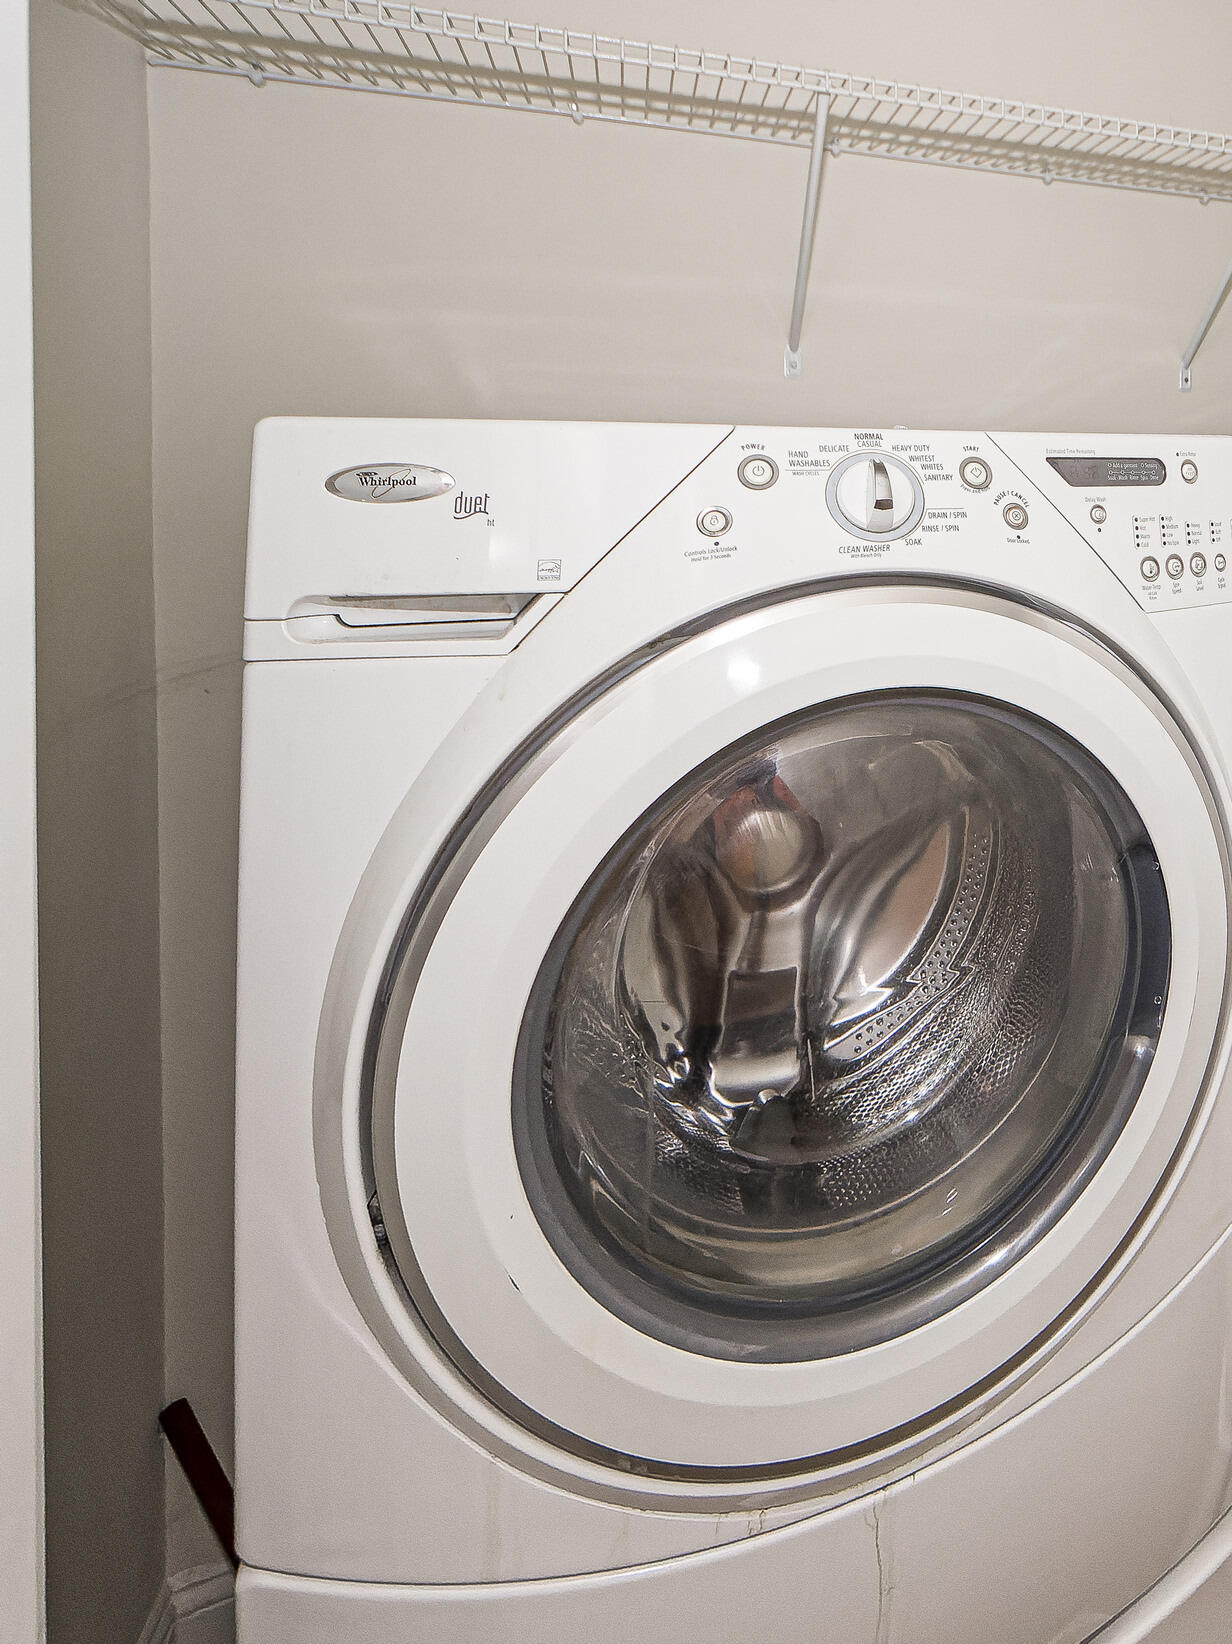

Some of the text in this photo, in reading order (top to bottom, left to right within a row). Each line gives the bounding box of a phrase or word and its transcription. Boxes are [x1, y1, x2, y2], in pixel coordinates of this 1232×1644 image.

[854, 433, 883, 441] NORMAL
[741, 443, 766, 451] POWER
[857, 440, 882, 448] CASUAL
[891, 444, 930, 452] HEAVY DUTY
[819, 445, 850, 453] DELICATE
[788, 451, 809, 459] HAND
[789, 459, 831, 467] WASHABLES
[921, 463, 944, 471] WHITES
[359, 475, 417, 489] Whirlpool
[993, 491, 1007, 506] PAUSE
[1010, 490, 1030, 508] CANCEL
[454, 491, 490, 520] duet
[952, 511, 968, 519] SPIN
[905, 538, 922, 546] SOAK
[838, 544, 891, 554] CLEAN WASHER
